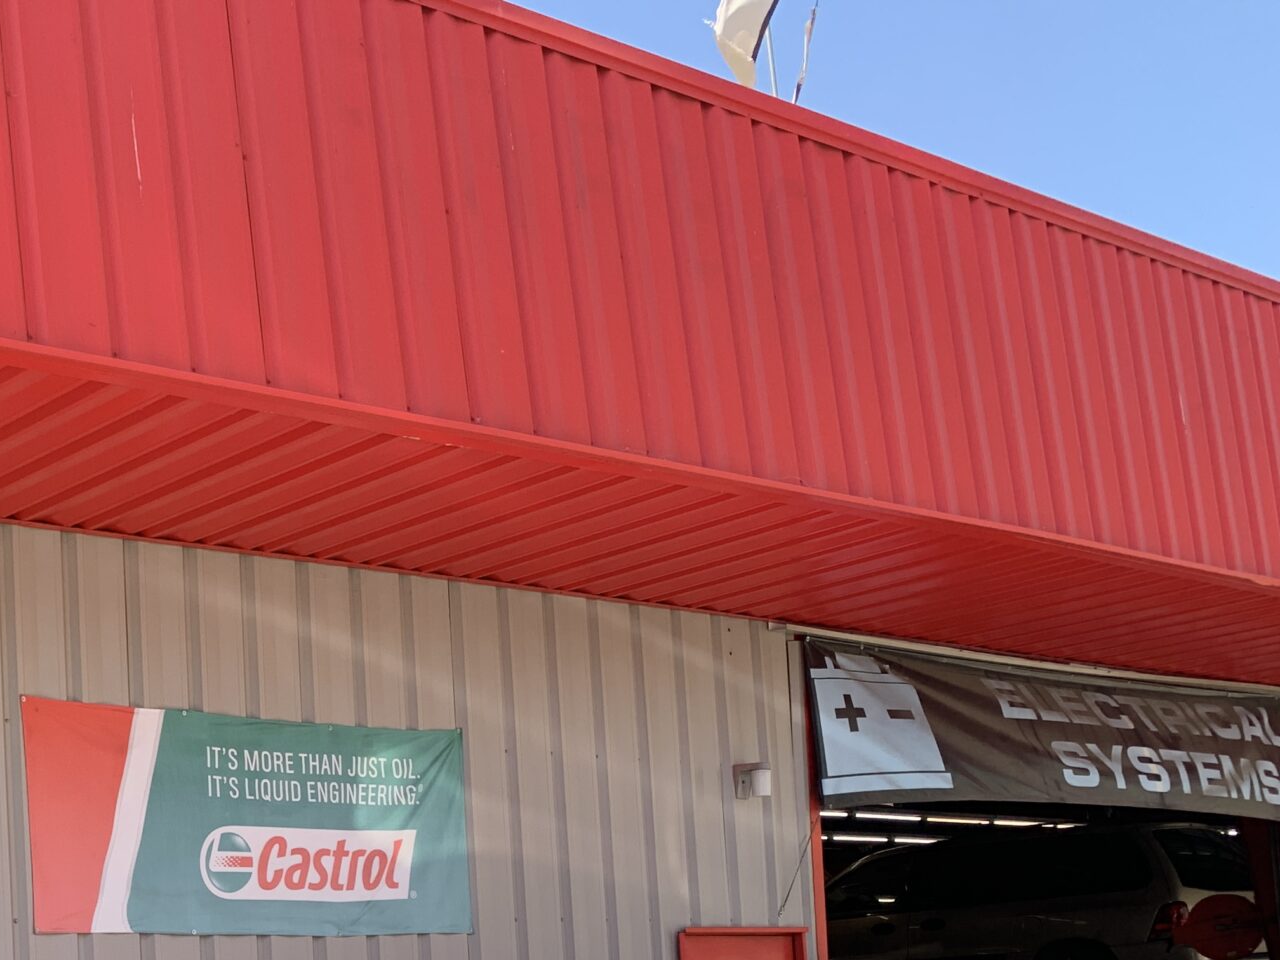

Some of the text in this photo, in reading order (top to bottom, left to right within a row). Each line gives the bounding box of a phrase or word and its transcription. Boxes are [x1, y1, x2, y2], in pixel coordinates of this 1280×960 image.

[206, 746, 421, 780] IT'S MORE THAN JUST OIL.
[1051, 740, 1280, 806] SYSTEMS
[207, 775, 239, 799] IT'S
[244, 778, 301, 802] LIQUID
[257, 835, 404, 892] Castrol
